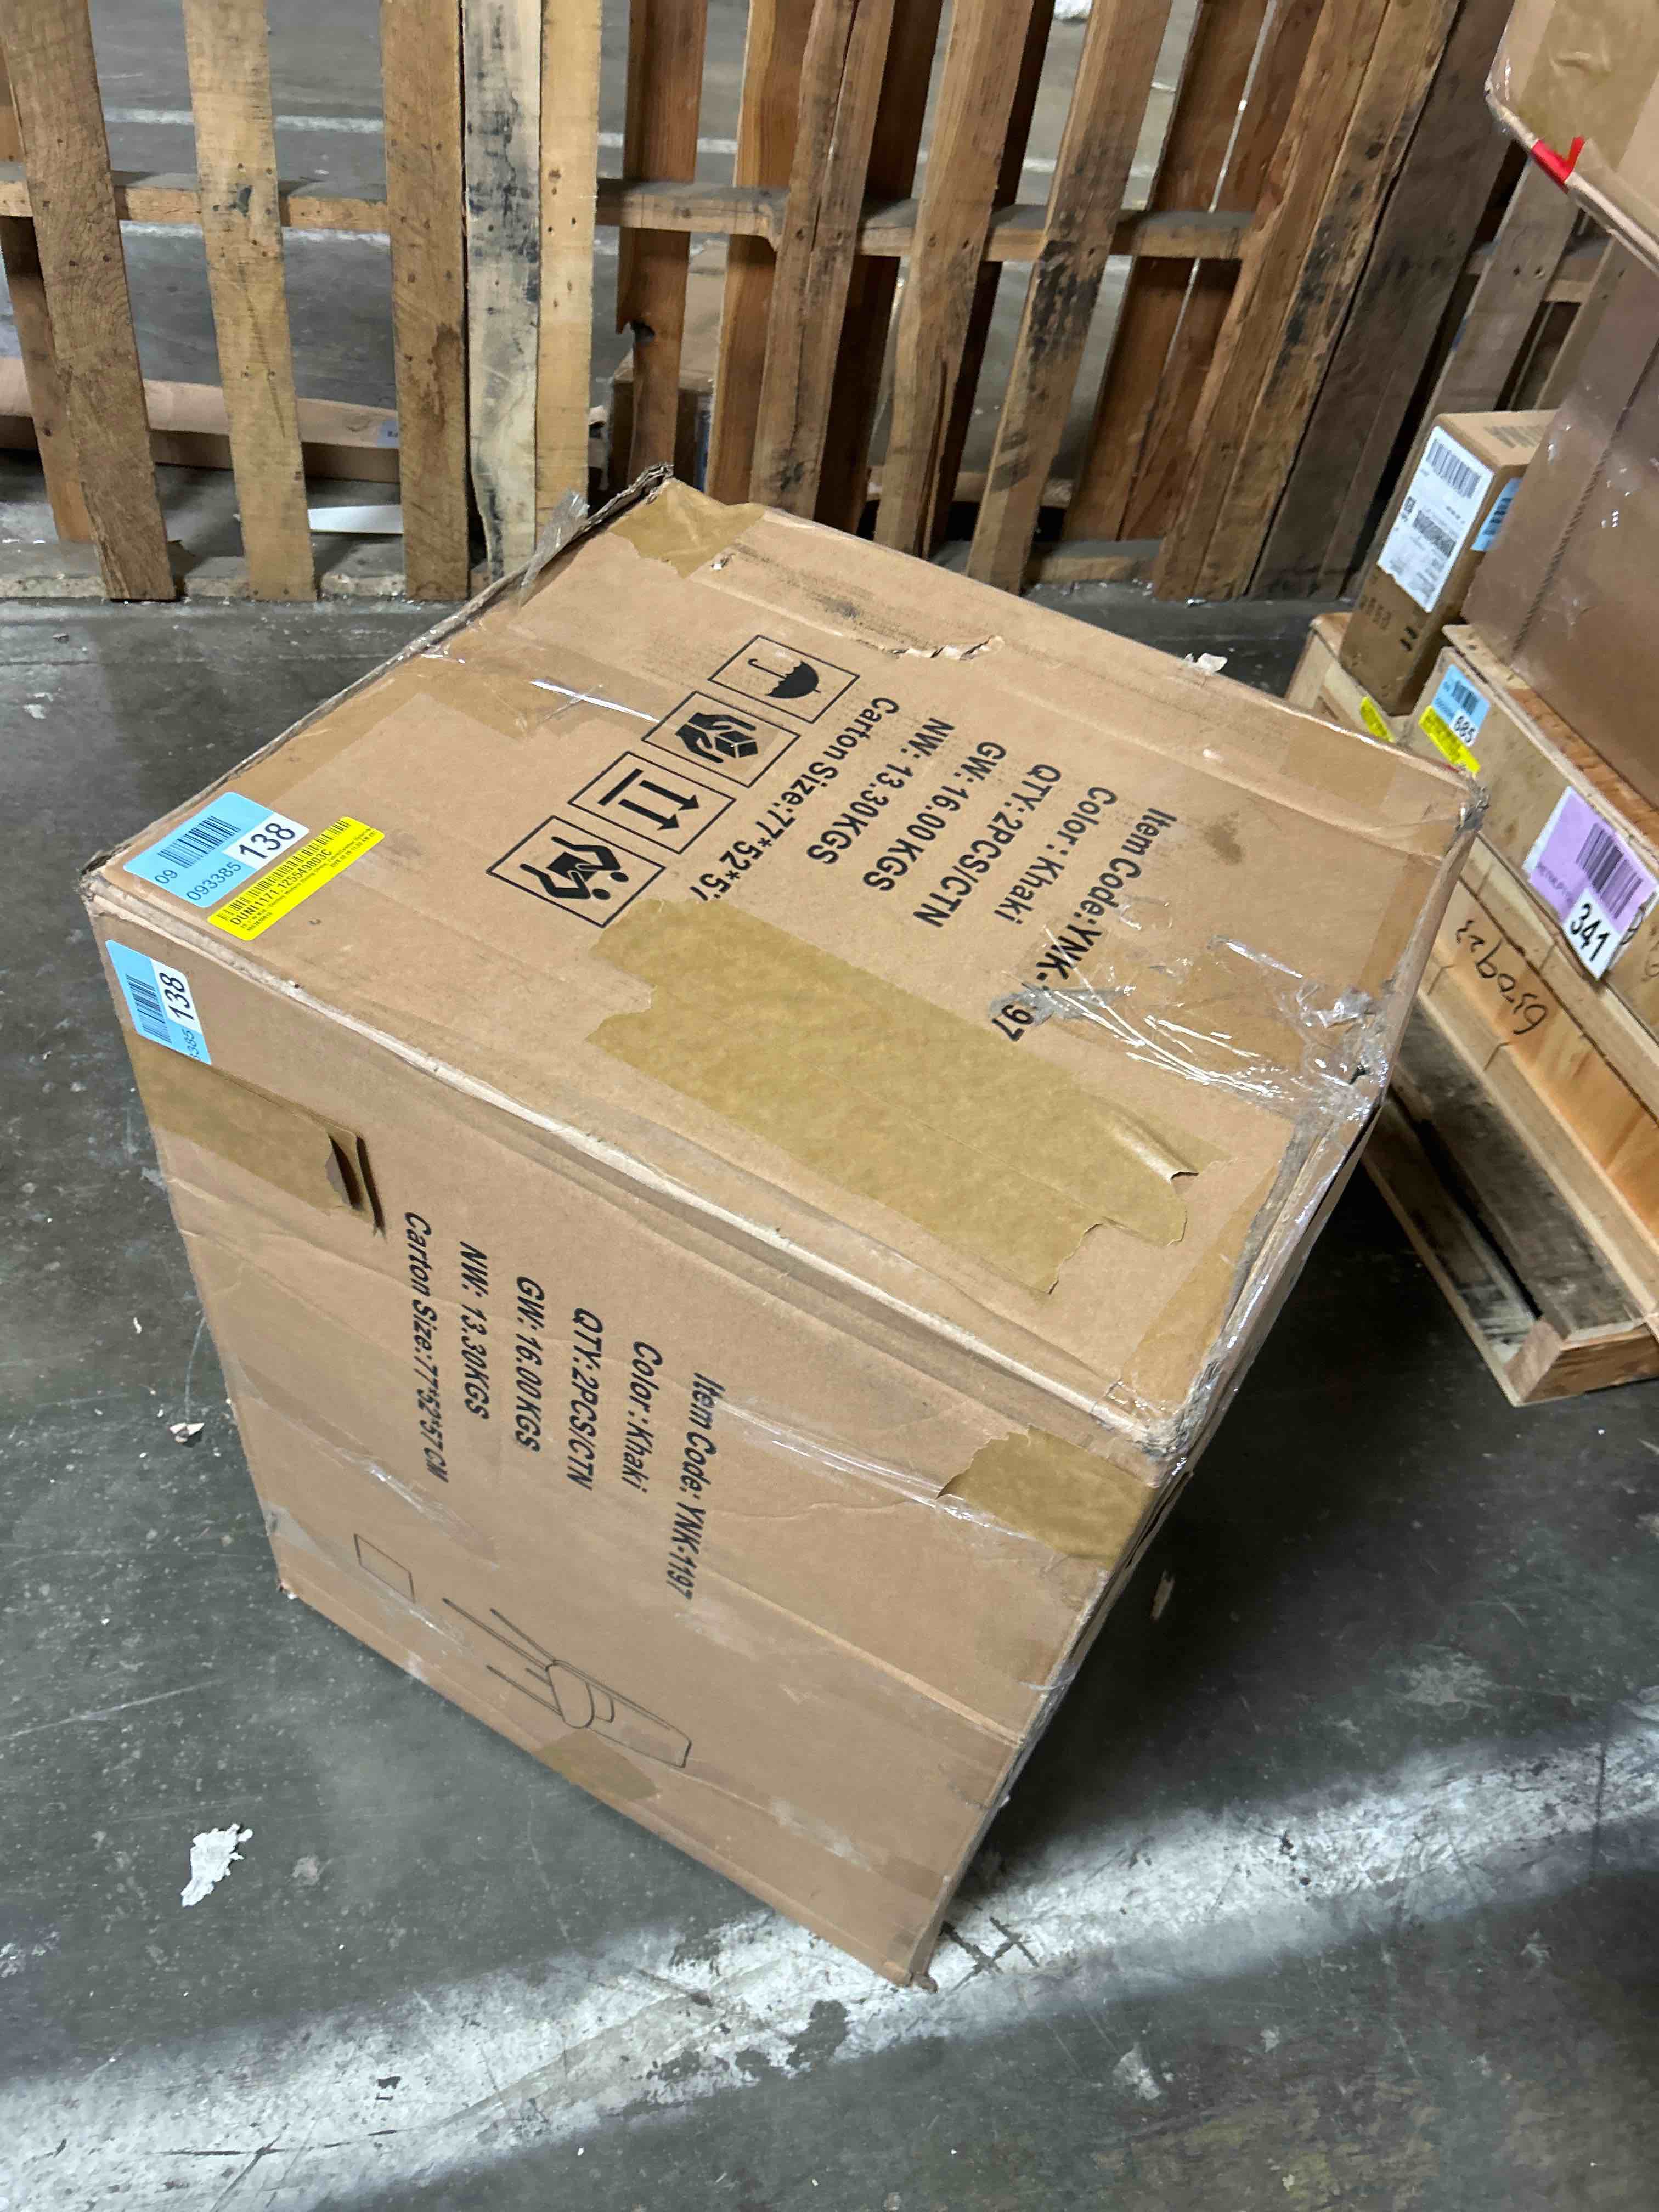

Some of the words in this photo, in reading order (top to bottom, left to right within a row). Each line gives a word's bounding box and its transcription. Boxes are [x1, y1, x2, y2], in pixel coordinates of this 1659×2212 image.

[823, 697, 900, 760] Carton
[900, 717, 955, 758] NW:
[953, 741, 1007, 783] GW:
[239, 823, 295, 859] 138
[806, 763, 913, 865] 13.30KGS
[1120, 807, 1177, 856] Item
[154, 870, 178, 884] 09
[186, 861, 242, 901] 093385
[994, 856, 1065, 925] Khaki
[1570, 903, 1610, 962] 341
[159, 973, 194, 1020] 138
[404, 1212, 432, 1296] Carton
[460, 1241, 488, 1297] NW:
[517, 1276, 545, 1330] GW:
[460, 1304, 489, 1419] 13.30KGS
[688, 1372, 726, 1430] Item
[621, 1421, 654, 1493] Khaki
[679, 1431, 717, 1500] Code:
